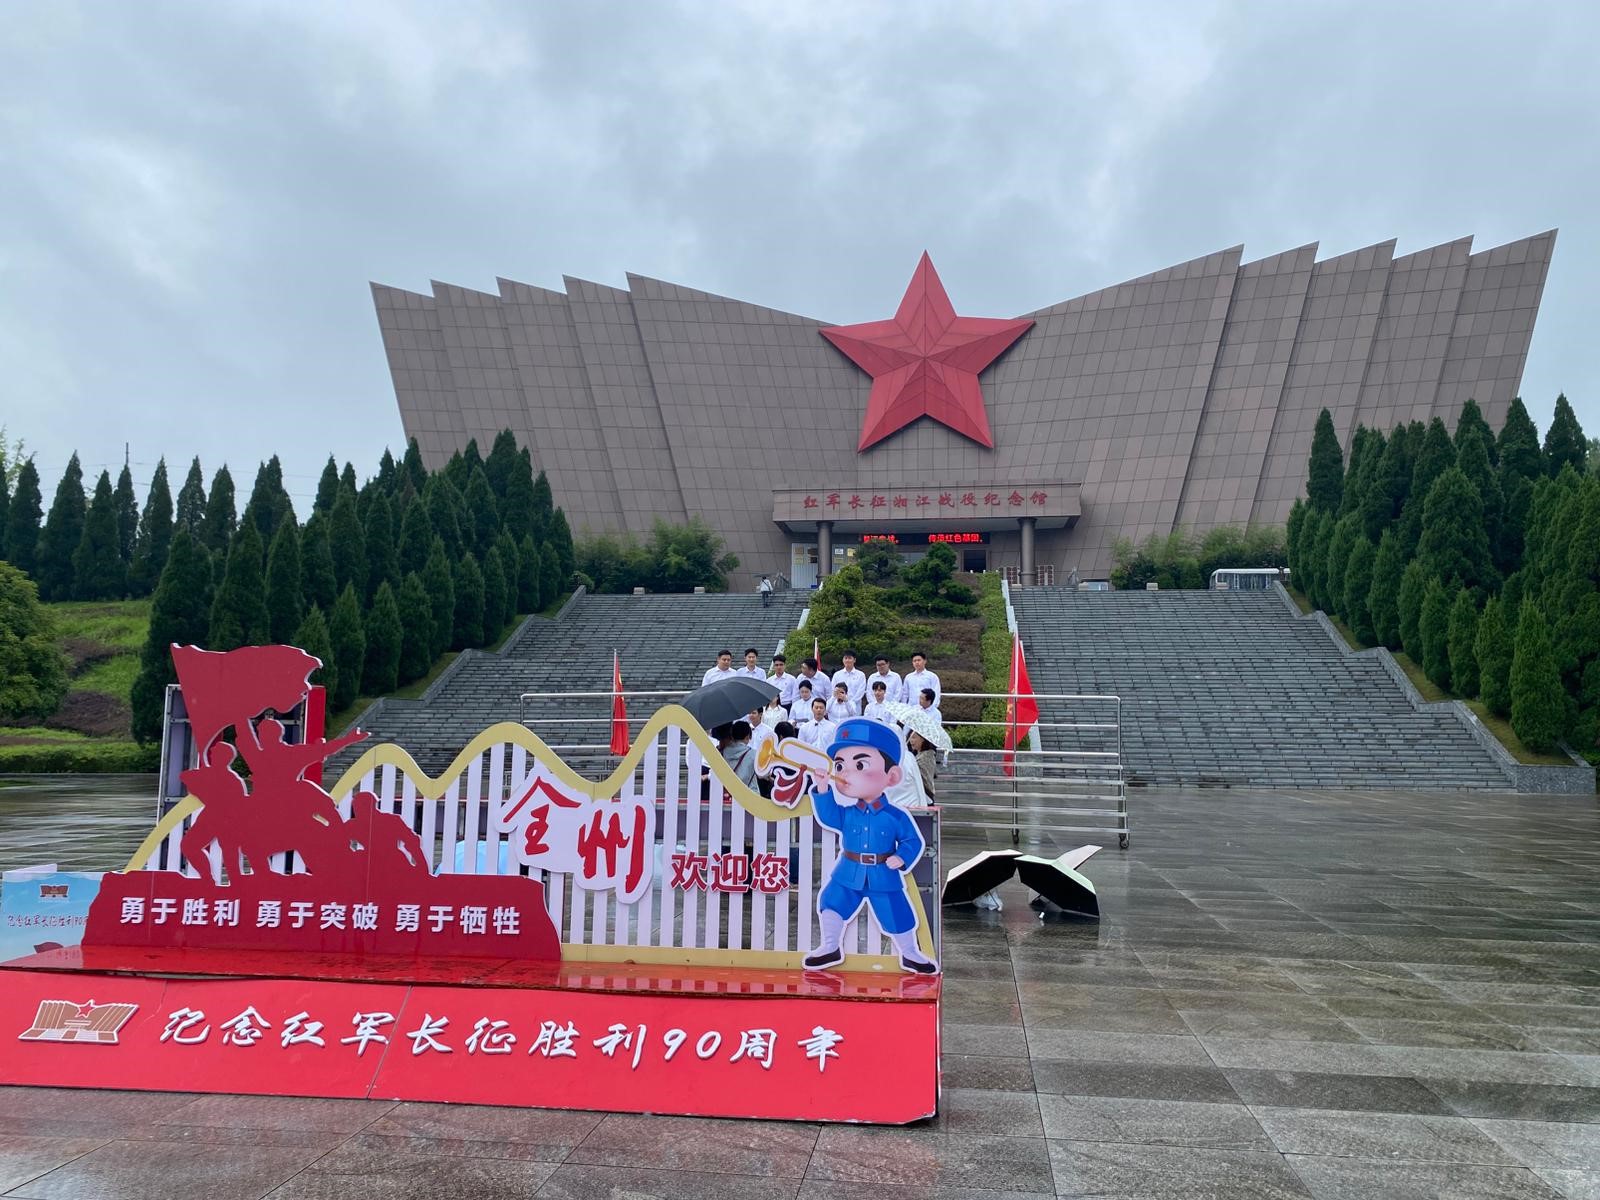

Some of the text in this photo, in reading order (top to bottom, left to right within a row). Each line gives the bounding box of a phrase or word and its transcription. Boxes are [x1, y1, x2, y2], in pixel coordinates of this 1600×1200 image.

[803, 490, 1048, 510] 红军长征湘江战役纪念馆
[502, 775, 790, 894] 全州 欢迎您
[119, 896, 521, 935] 勇于胜利 勇于突破 勇于牺牲
[159, 1005, 844, 1072] 纪念红军长征胜利90周年
